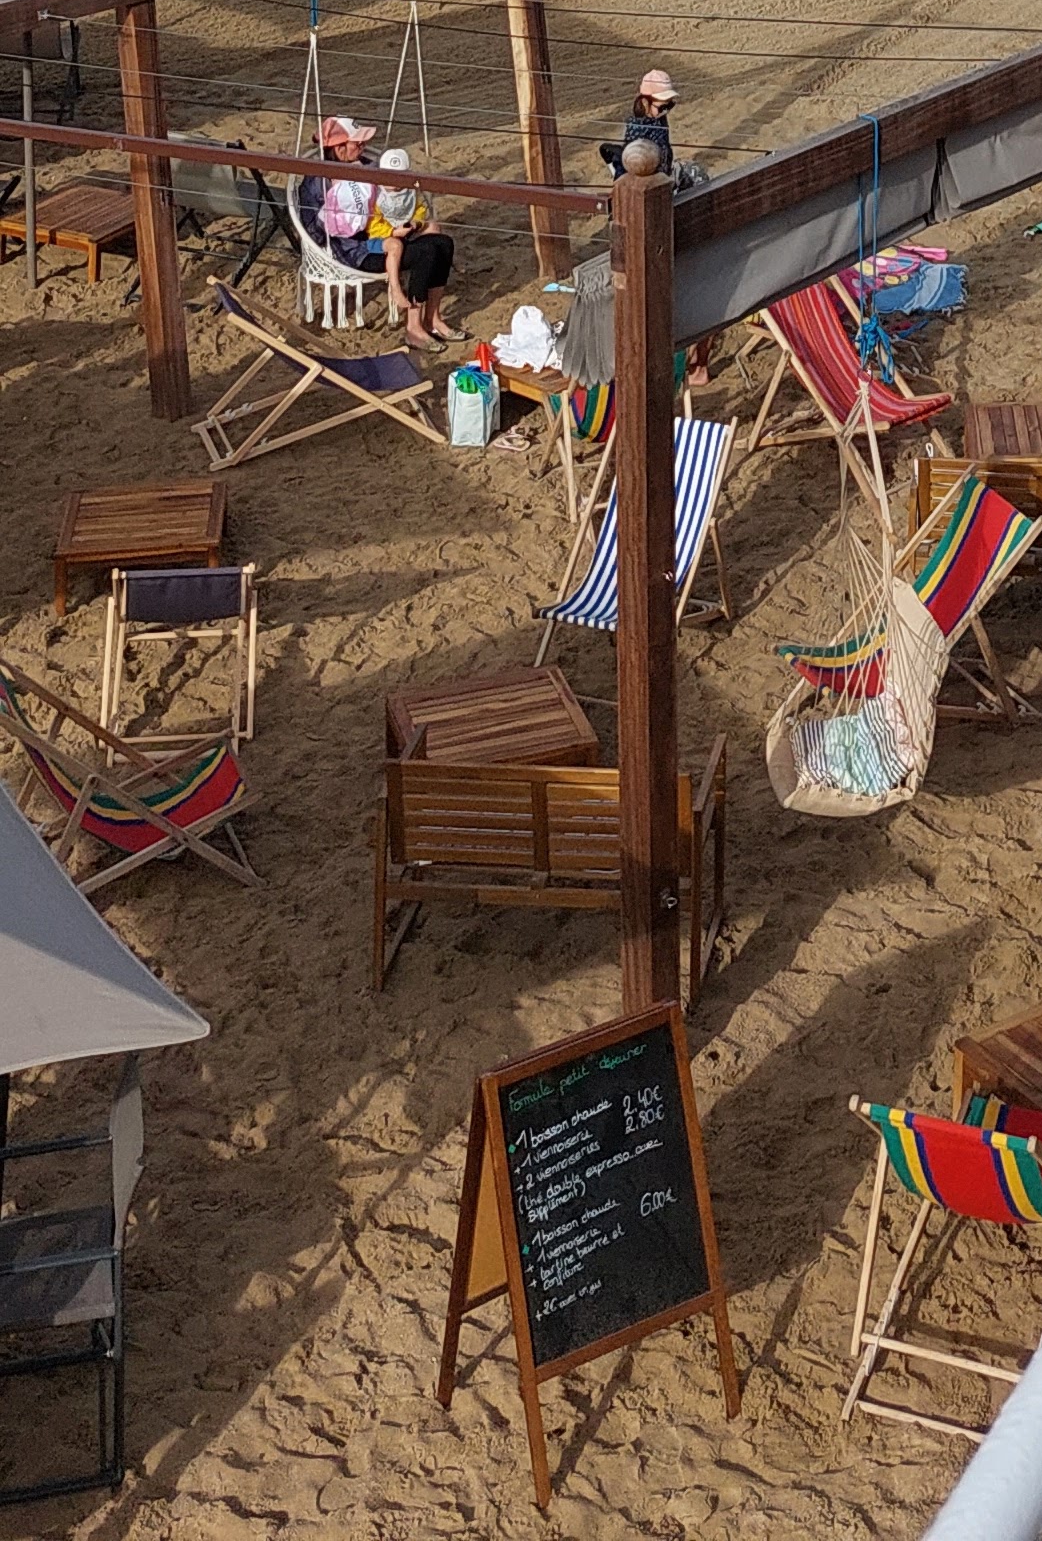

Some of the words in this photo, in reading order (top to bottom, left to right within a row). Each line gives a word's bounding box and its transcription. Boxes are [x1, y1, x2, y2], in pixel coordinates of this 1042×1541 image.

[509, 1079, 554, 1112] Formule
[559, 1065, 590, 1096] petit
[531, 1120, 569, 1149] boisson
[571, 1098, 612, 1127] chaude
[526, 1175, 535, 1190] 2
[542, 1220, 579, 1246] boisson
[581, 1198, 621, 1224] chaude
[540, 1253, 576, 1281] tartine
[612, 1222, 626, 1240] et
